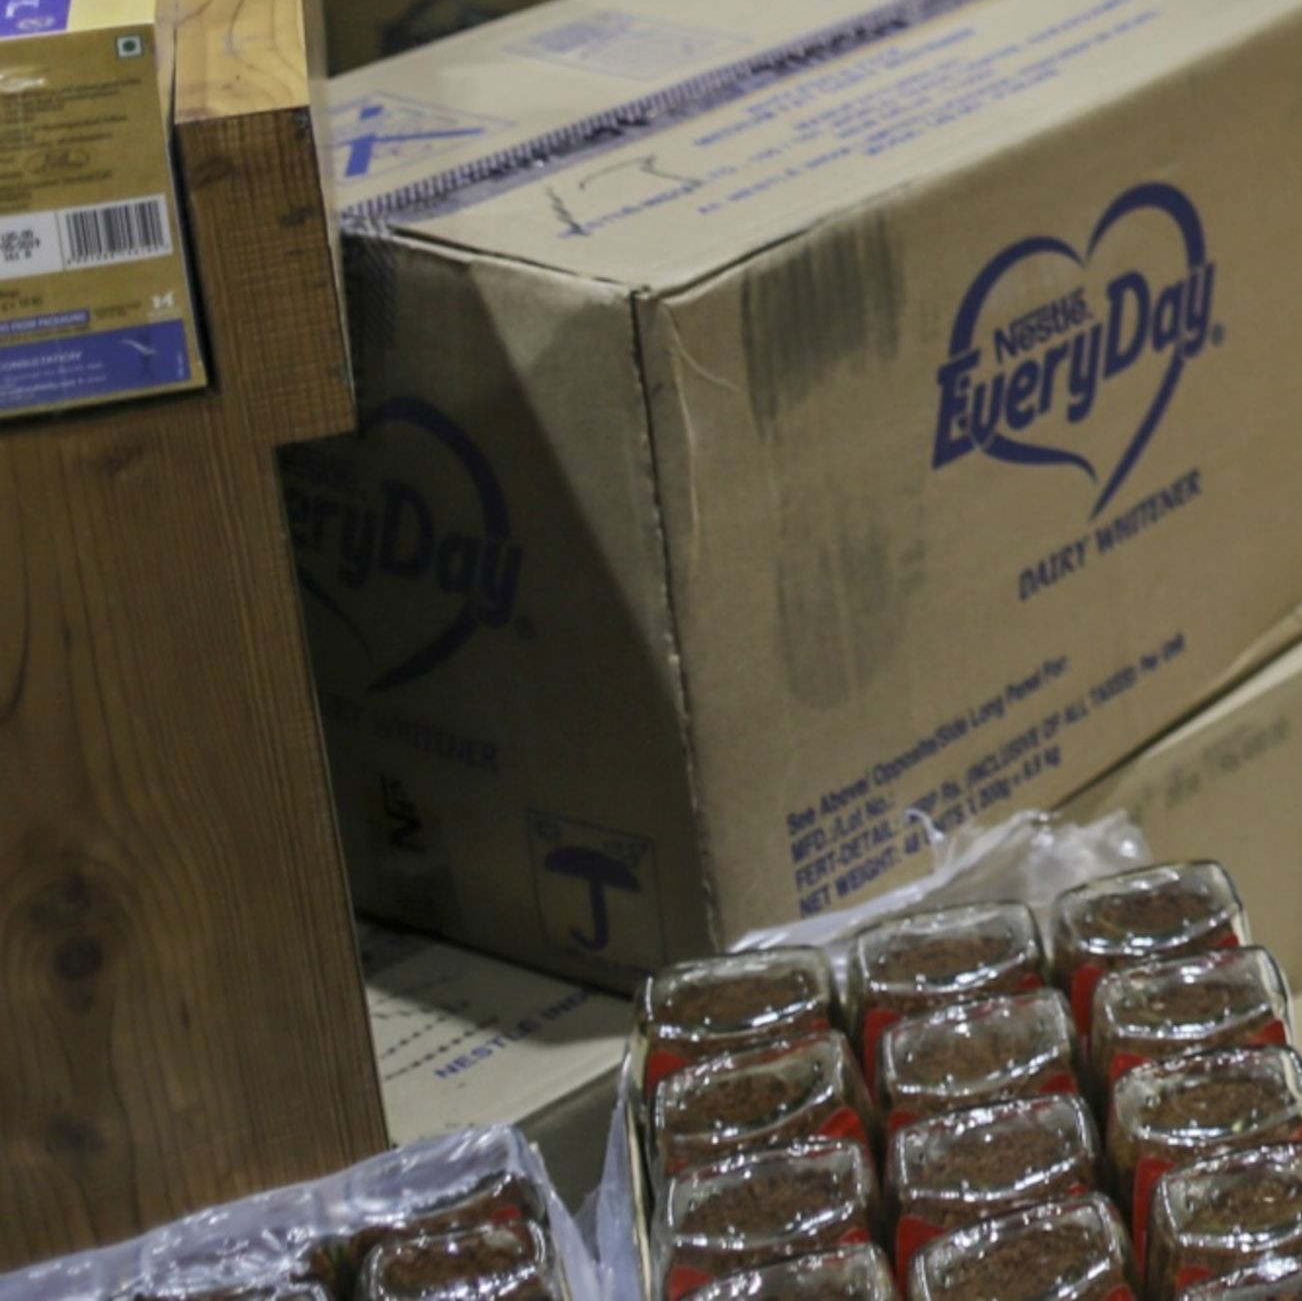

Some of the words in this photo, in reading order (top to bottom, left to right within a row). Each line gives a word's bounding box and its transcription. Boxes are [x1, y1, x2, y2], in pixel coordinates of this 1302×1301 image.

[931, 261, 1216, 471] EveryDay
[1018, 534, 1089, 602] DAIRY
[1095, 469, 1203, 556] WHITENER
